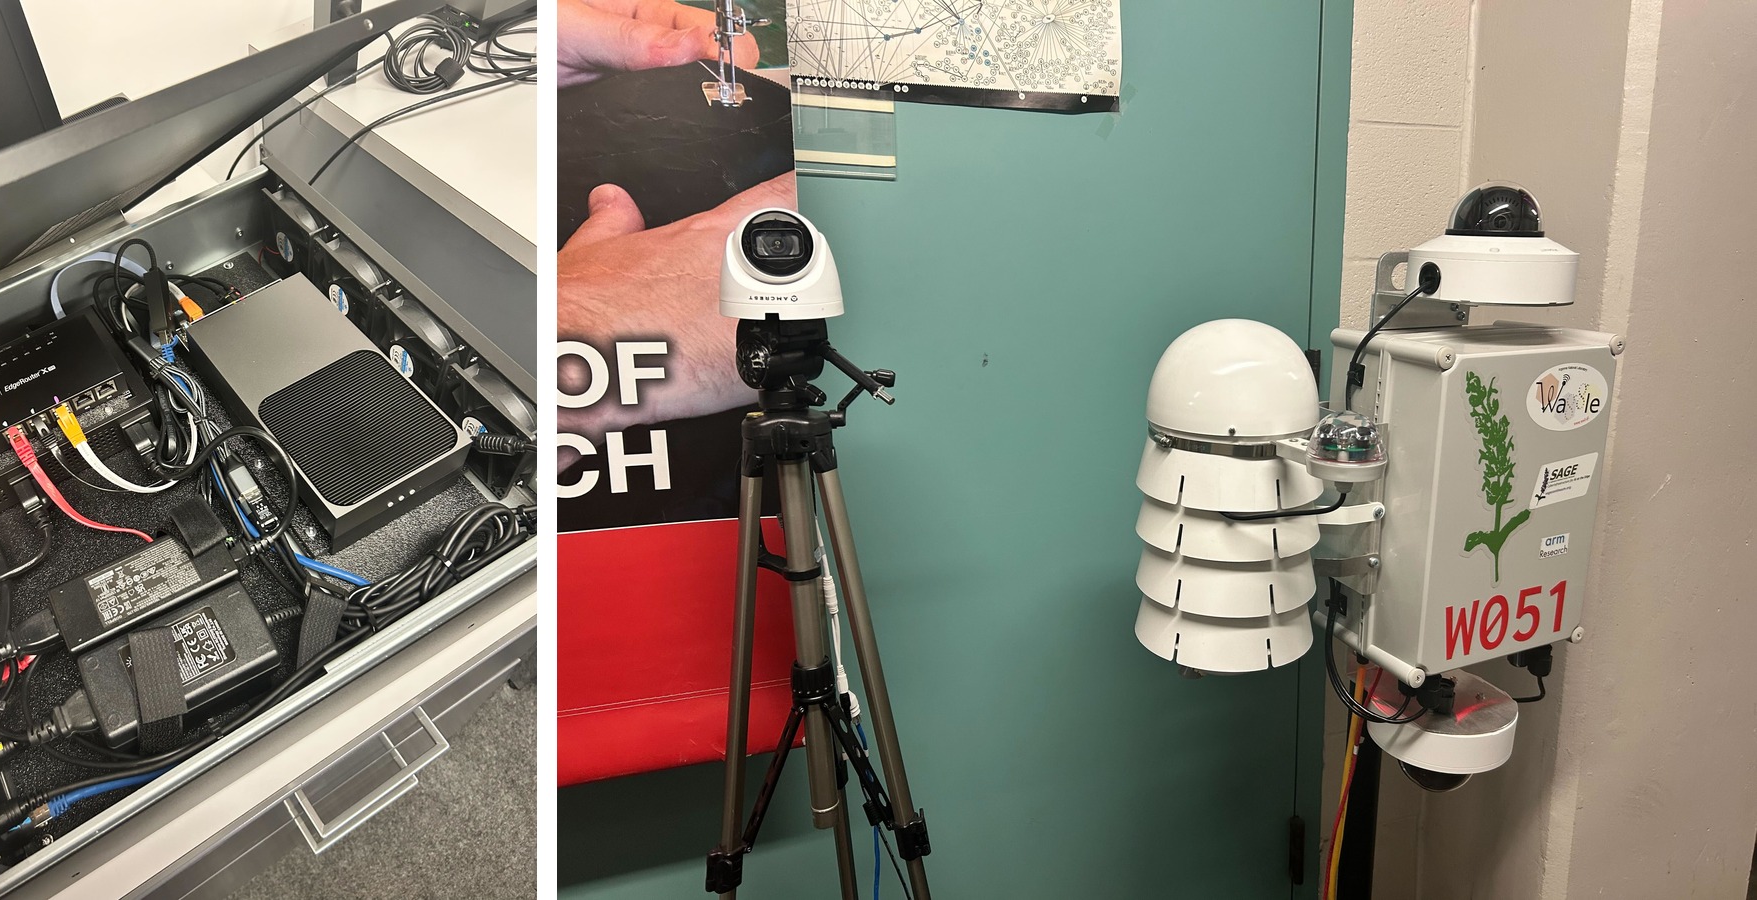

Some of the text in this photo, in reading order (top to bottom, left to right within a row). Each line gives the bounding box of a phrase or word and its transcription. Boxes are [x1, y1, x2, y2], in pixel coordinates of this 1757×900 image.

[4, 370, 40, 392] EdgeRouter
[557, 340, 668, 408] OF
[1550, 464, 1578, 480] SAGE
[1546, 535, 1564, 546] arm
[1540, 545, 1568, 558] Research
[1446, 580, 1567, 660] W051
